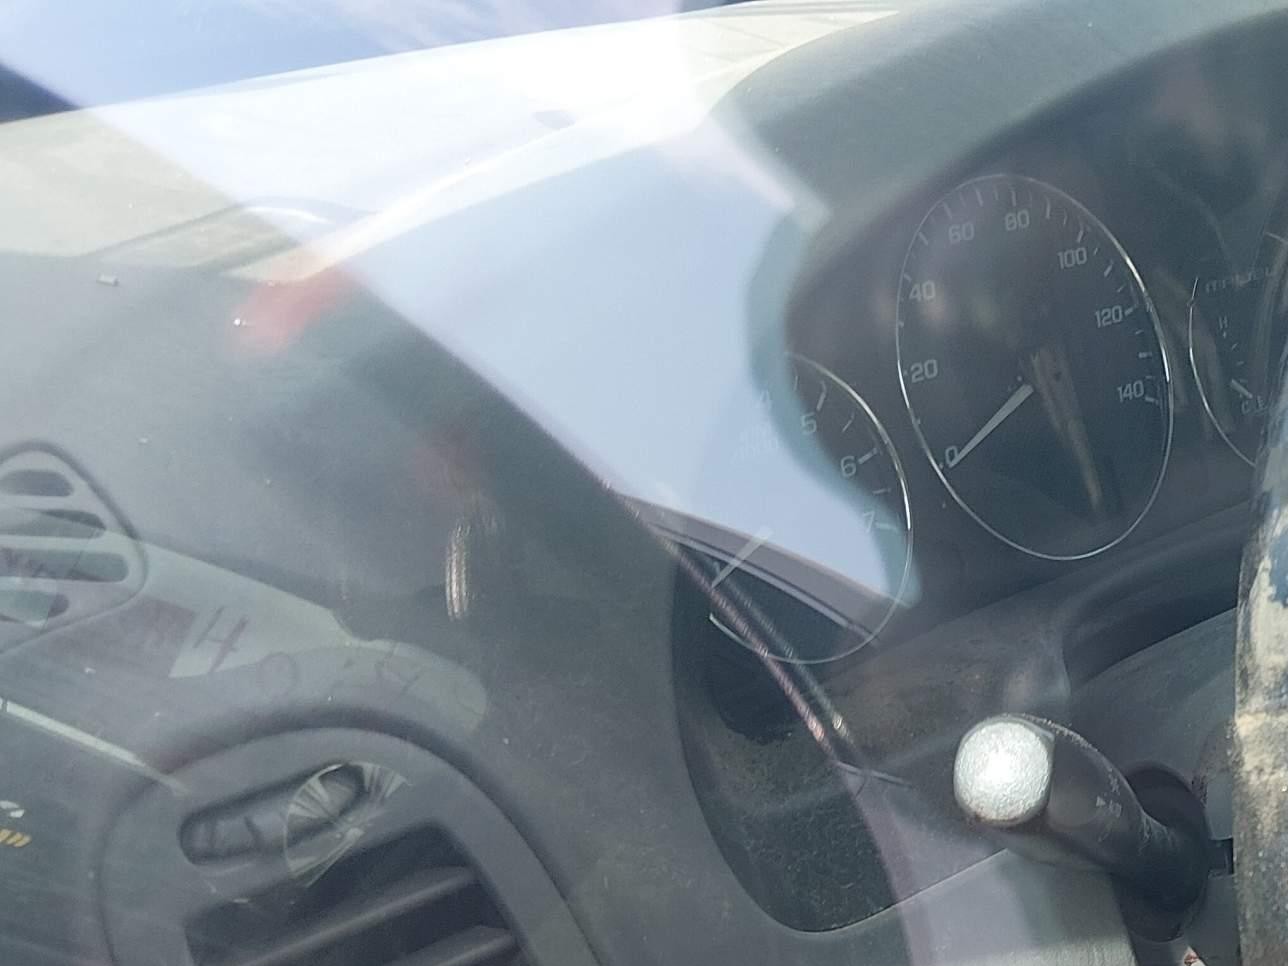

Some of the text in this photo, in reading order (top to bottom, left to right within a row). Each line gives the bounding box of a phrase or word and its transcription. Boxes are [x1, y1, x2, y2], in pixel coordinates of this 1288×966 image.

[1004, 208, 1030, 231] 80
[948, 222, 975, 244] 60
[1058, 246, 1088, 269] 100
[909, 279, 937, 301] 40
[1095, 304, 1123, 328] 120
[911, 358, 939, 383] 20
[1117, 379, 1145, 402] 140
[800, 411, 818, 436] 5
[839, 455, 858, 478] 6
[863, 509, 876, 533] 7
